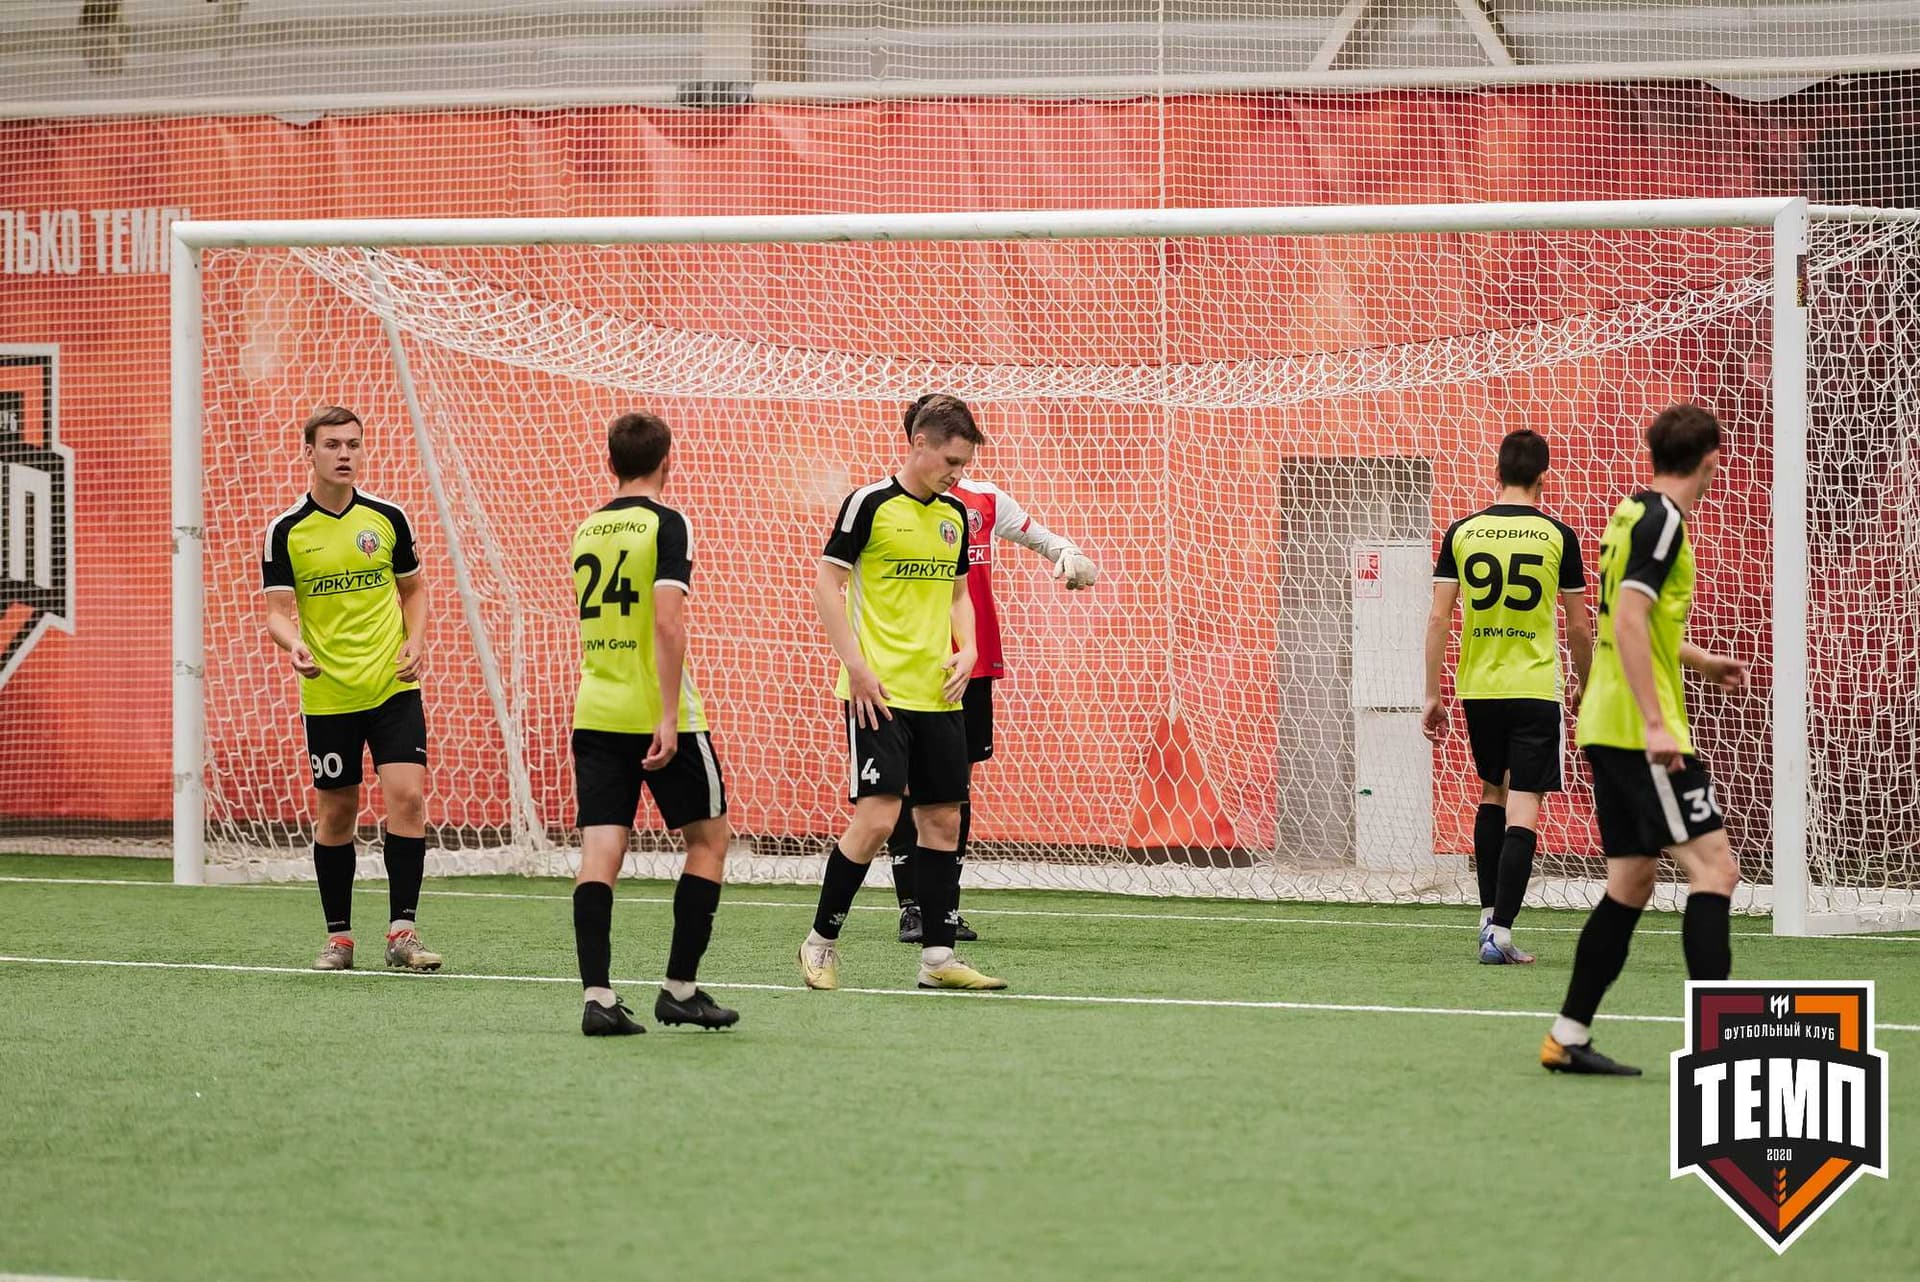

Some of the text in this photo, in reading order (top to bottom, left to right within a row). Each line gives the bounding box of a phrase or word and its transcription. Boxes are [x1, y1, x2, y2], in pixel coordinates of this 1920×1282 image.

[1475, 528, 1550, 541] сервико
[312, 570, 384, 594] ИРКУТСК
[573, 549, 640, 620] 24
[1464, 552, 1544, 612] 95
[608, 638, 637, 650] Group
[1483, 627, 1536, 640] RVM Group
[311, 752, 343, 779] 90
[861, 758, 881, 785] 4
